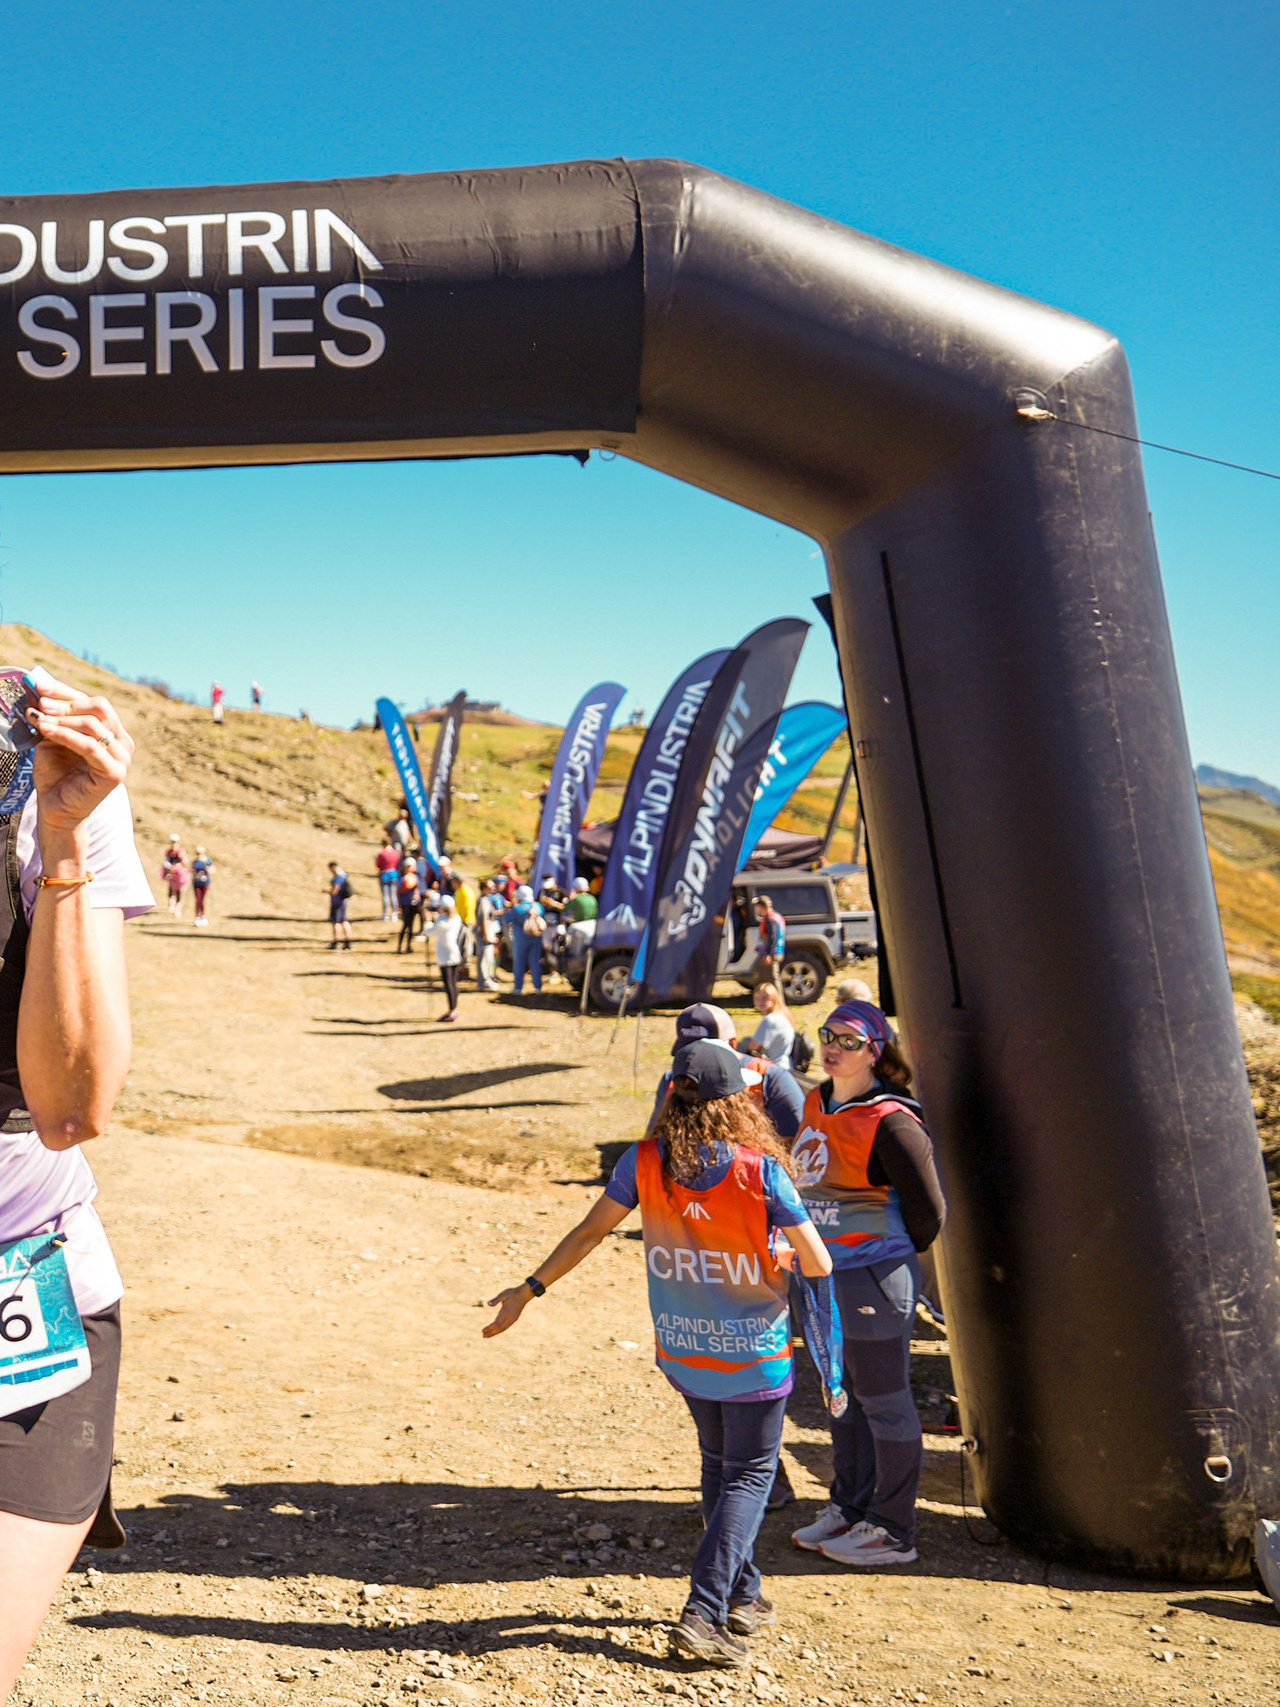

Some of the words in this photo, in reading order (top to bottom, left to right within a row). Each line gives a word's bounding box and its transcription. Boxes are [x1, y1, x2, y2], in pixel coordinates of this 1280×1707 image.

[16, 282, 387, 379] SERIES
[548, 702, 608, 871] ALPINDUSTRIA
[622, 679, 713, 891] ALPINDUSTRIA
[683, 680, 752, 896] DYNAFIT
[648, 1245, 761, 1286] CREW
[656, 1312, 775, 1335] ALPINDUSTRIA
[656, 1327, 705, 1351] TRAIL
[708, 1332, 778, 1353] SERIES
